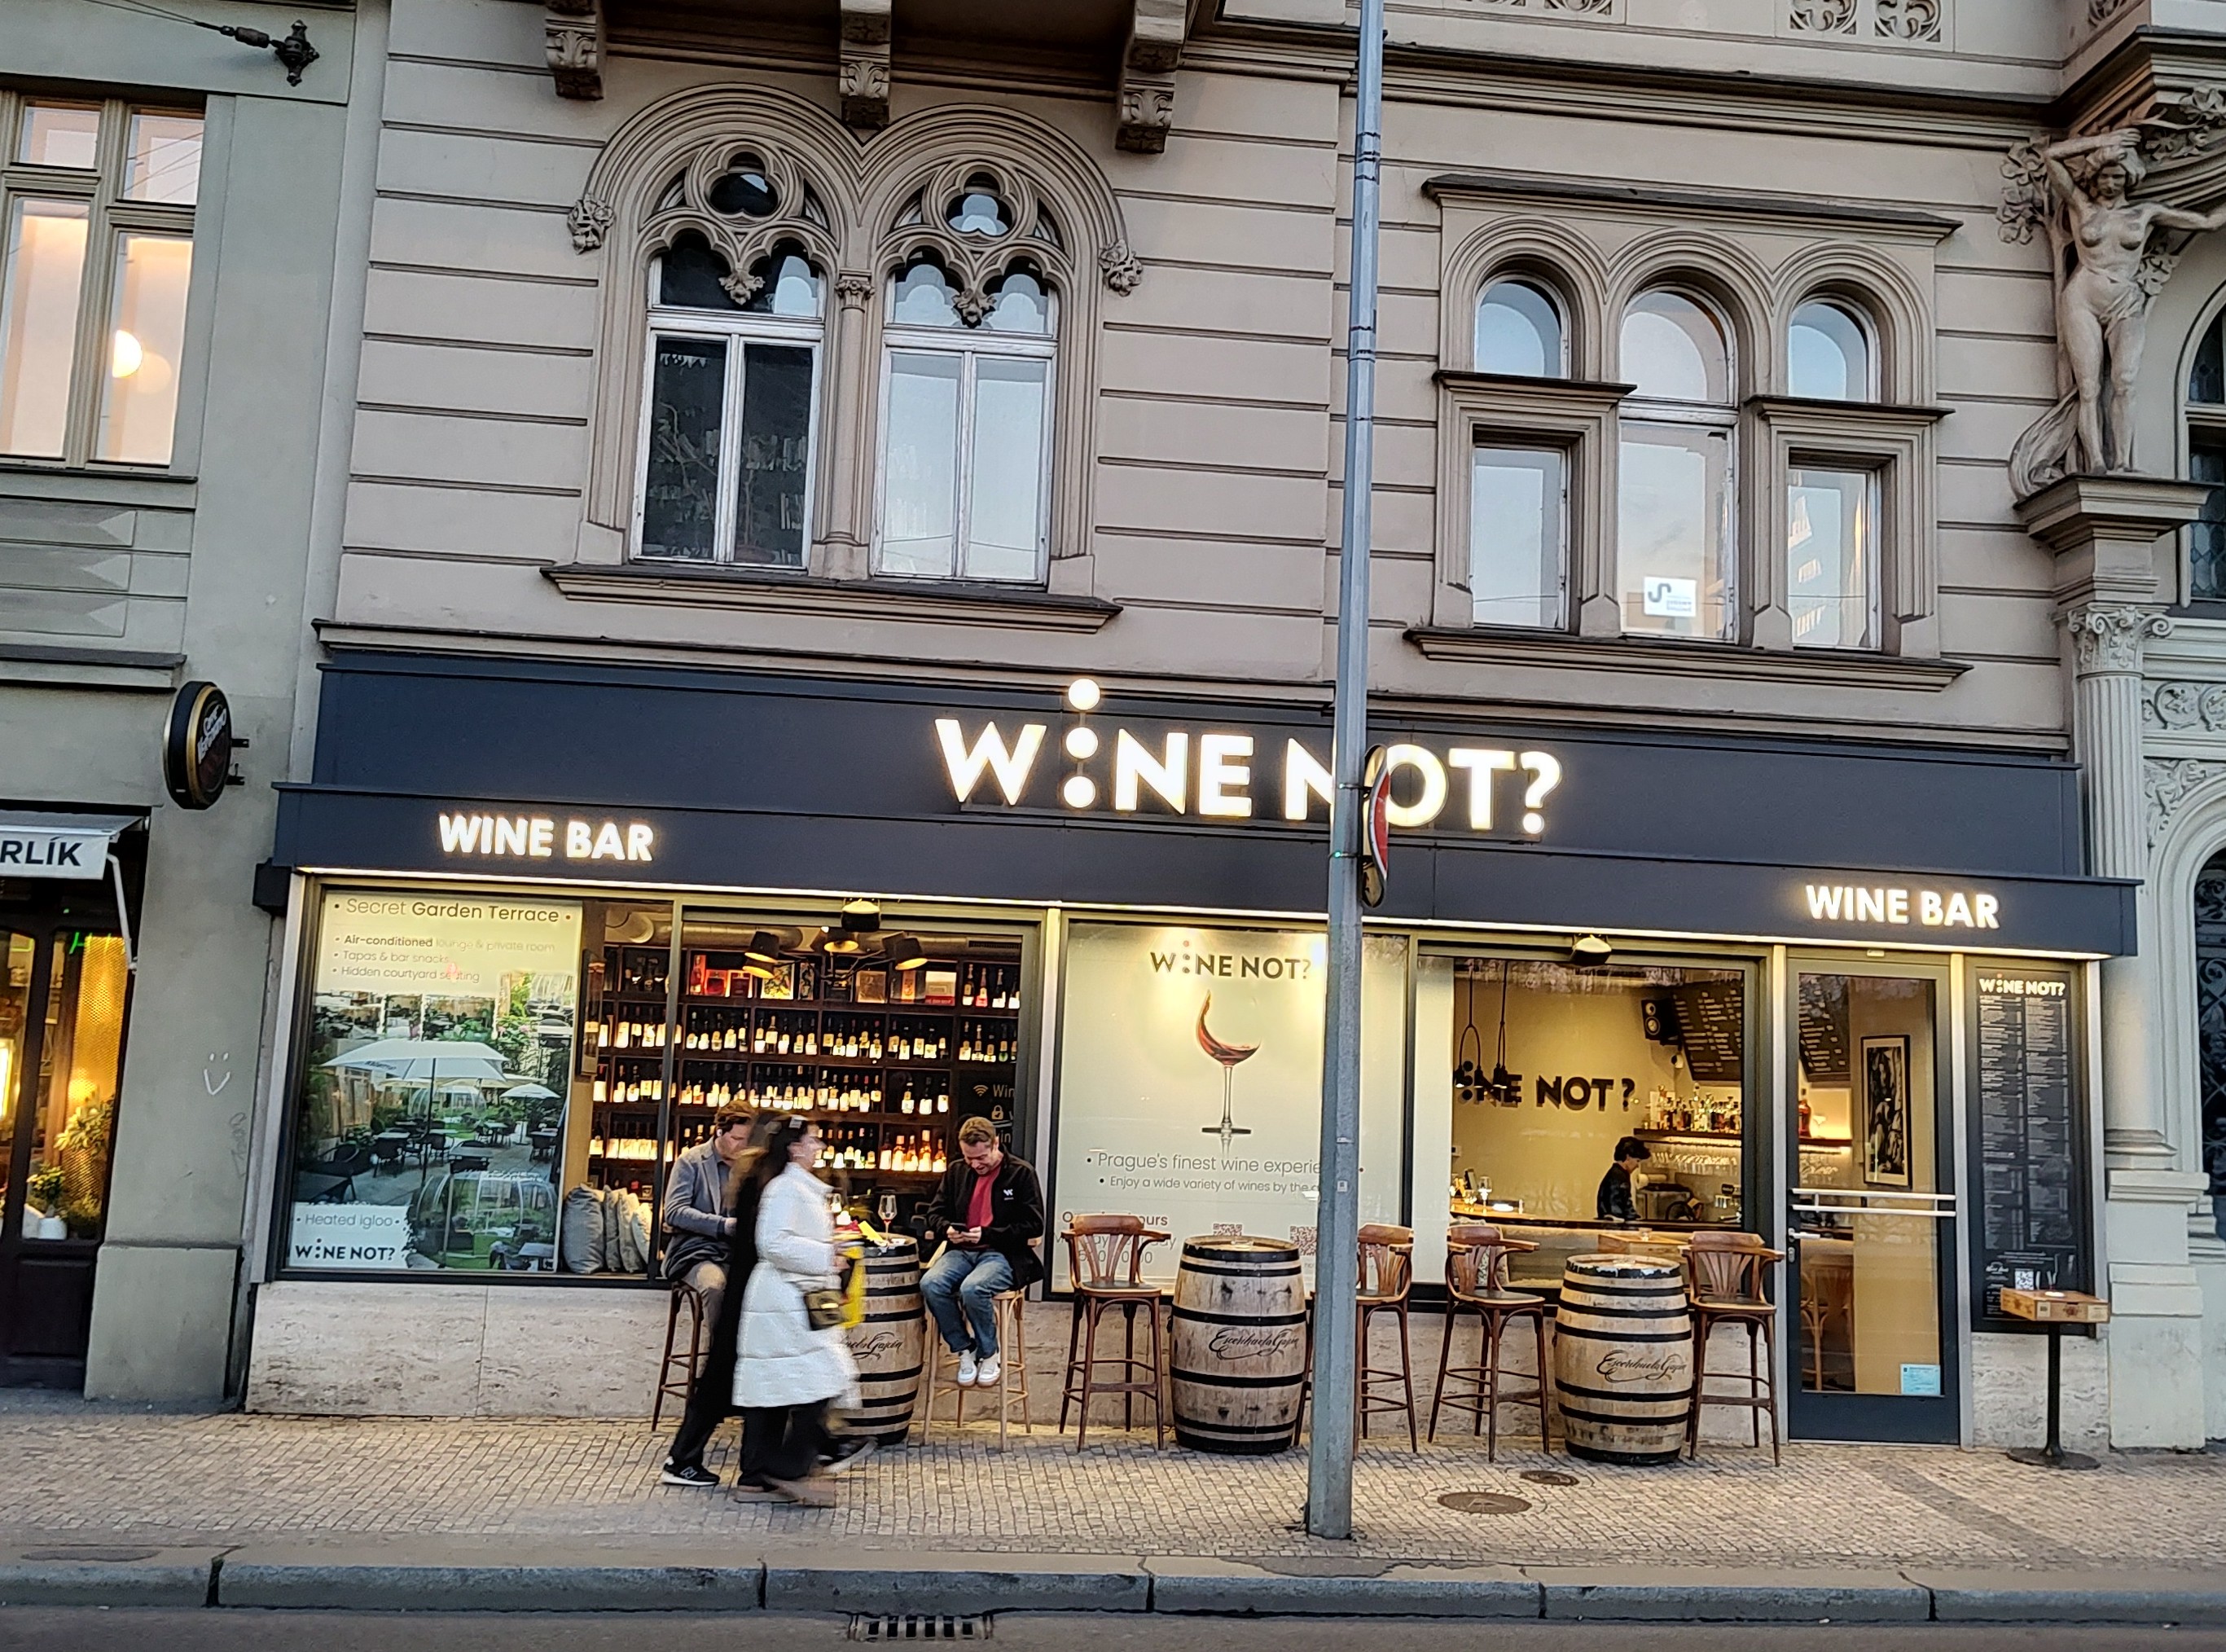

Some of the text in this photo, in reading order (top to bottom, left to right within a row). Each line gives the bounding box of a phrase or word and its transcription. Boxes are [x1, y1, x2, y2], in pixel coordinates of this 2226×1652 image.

[439, 815, 654, 861] WINE BAR
[346, 898, 560, 922] Secret Garden Terrace
[1806, 885, 2000, 929] WINE BAR
[344, 934, 433, 947] Air-conditioned
[343, 950, 377, 962] Tapas
[380, 951, 388, 961] &
[391, 952, 411, 962] bar
[342, 966, 381, 978] Hidden
[383, 968, 437, 981] courtyard
[1240, 955, 1311, 980] NOT?
[2025, 980, 2066, 996] NOT?
[1098, 1152, 1168, 1172] Prague's
[1173, 1153, 1217, 1171] finest
[1221, 1157, 1259, 1171] wine
[1110, 1175, 1140, 1189] Enjoy
[1143, 1179, 1150, 1188] a
[1153, 1177, 1180, 1188] wide
[1183, 1179, 1221, 1192] variety
[1223, 1180, 1236, 1190] of
[1238, 1180, 1271, 1192] wines
[1273, 1181, 1287, 1194] by
[1289, 1183, 1309, 1193] the
[305, 1213, 357, 1226] Heated
[350, 1246, 396, 1261] NOT?
